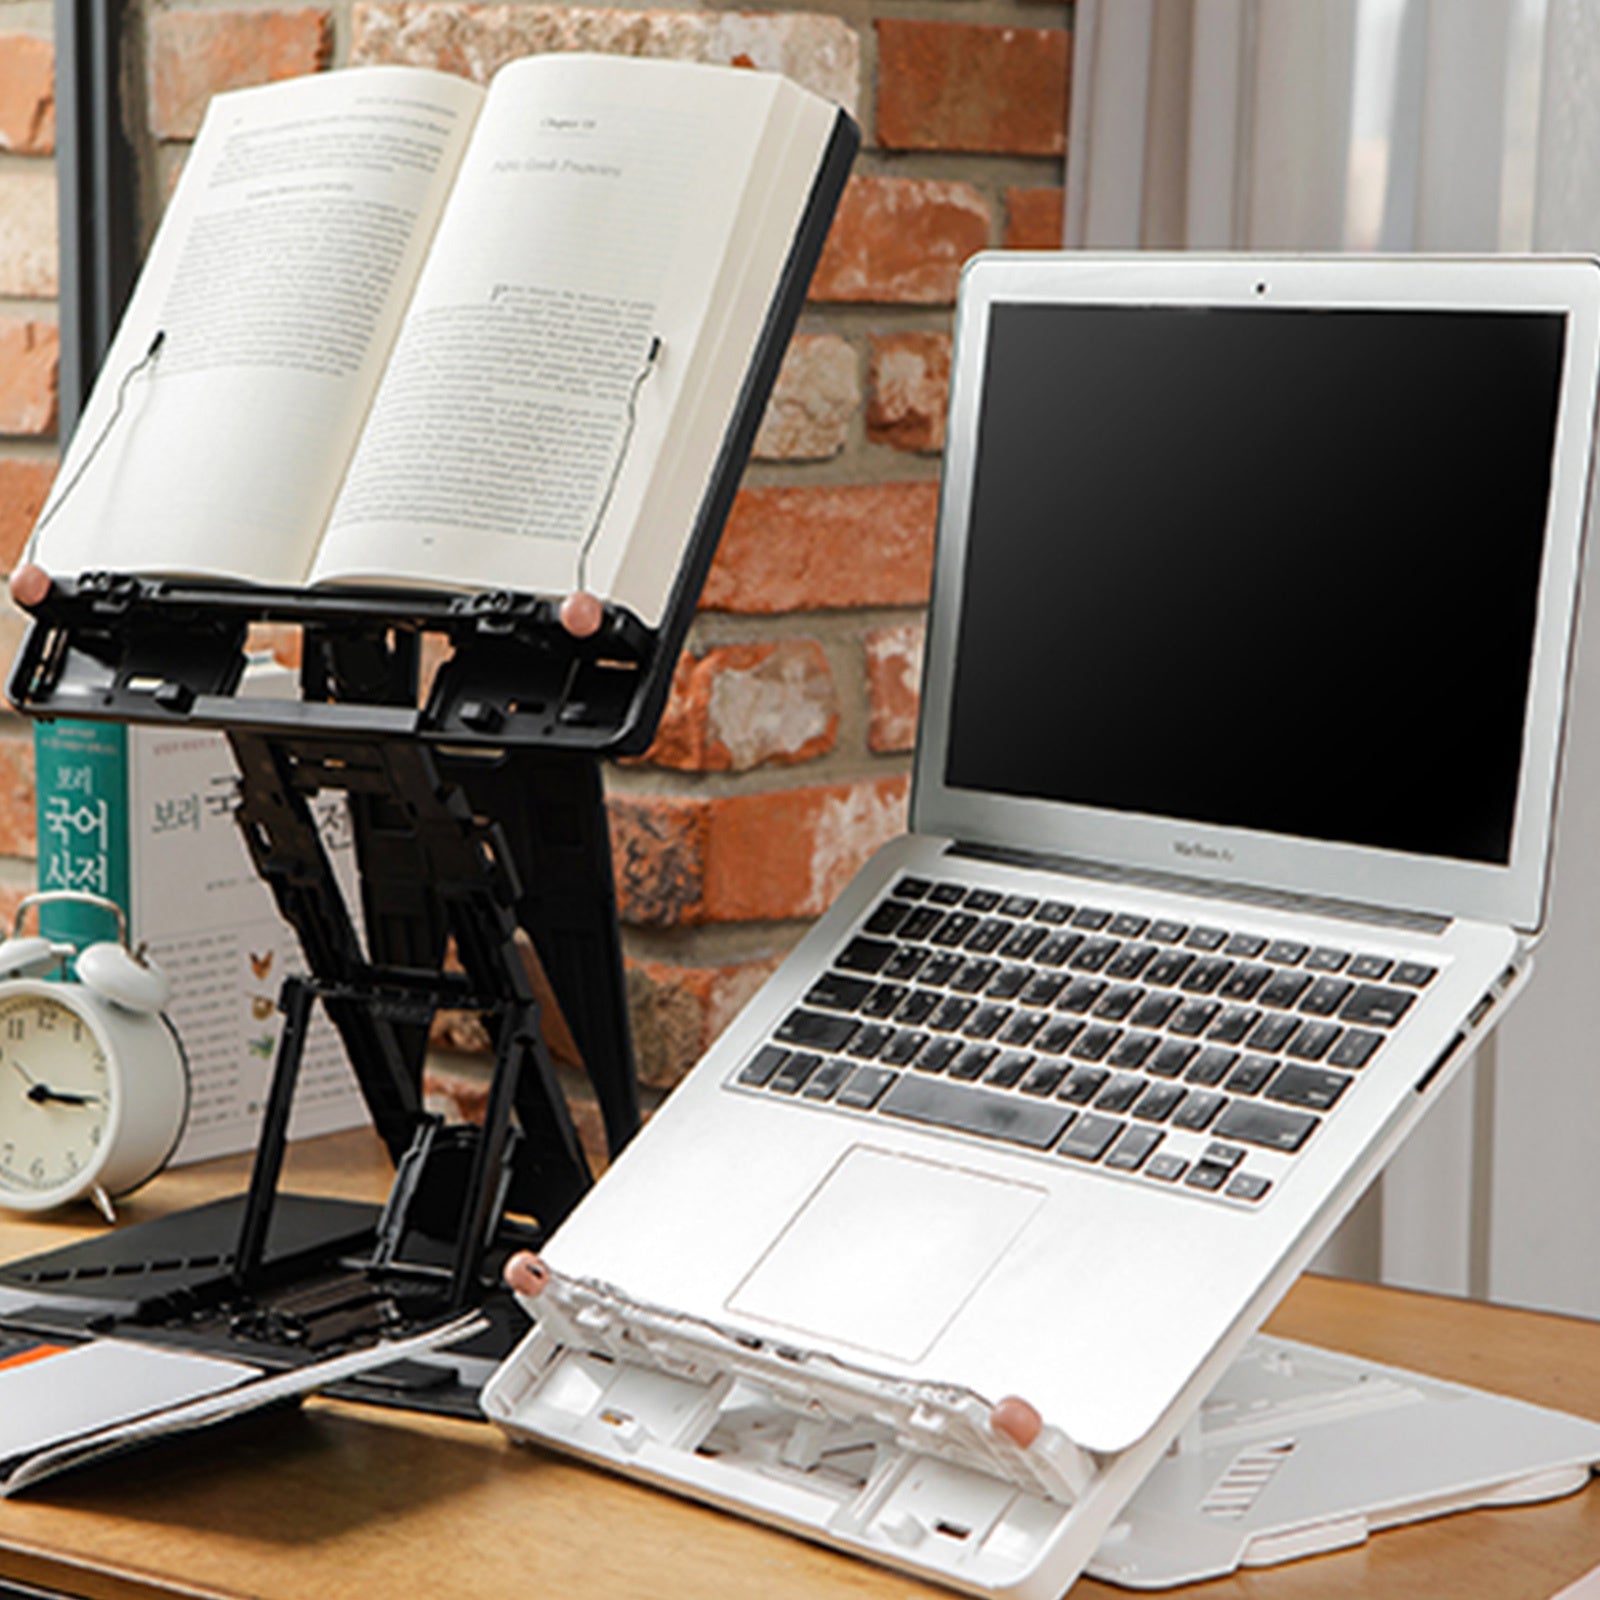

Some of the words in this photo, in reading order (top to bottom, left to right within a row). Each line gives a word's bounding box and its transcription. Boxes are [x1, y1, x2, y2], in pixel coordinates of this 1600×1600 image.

[56, 764, 93, 796] 보리
[44, 796, 108, 851] 국어
[151, 793, 200, 834] 보리
[45, 848, 108, 894] 사전
[8, 1018, 24, 1039] 11
[37, 1006, 58, 1030] 12
[72, 1020, 82, 1042] 1
[30, 1156, 45, 1180] 6
